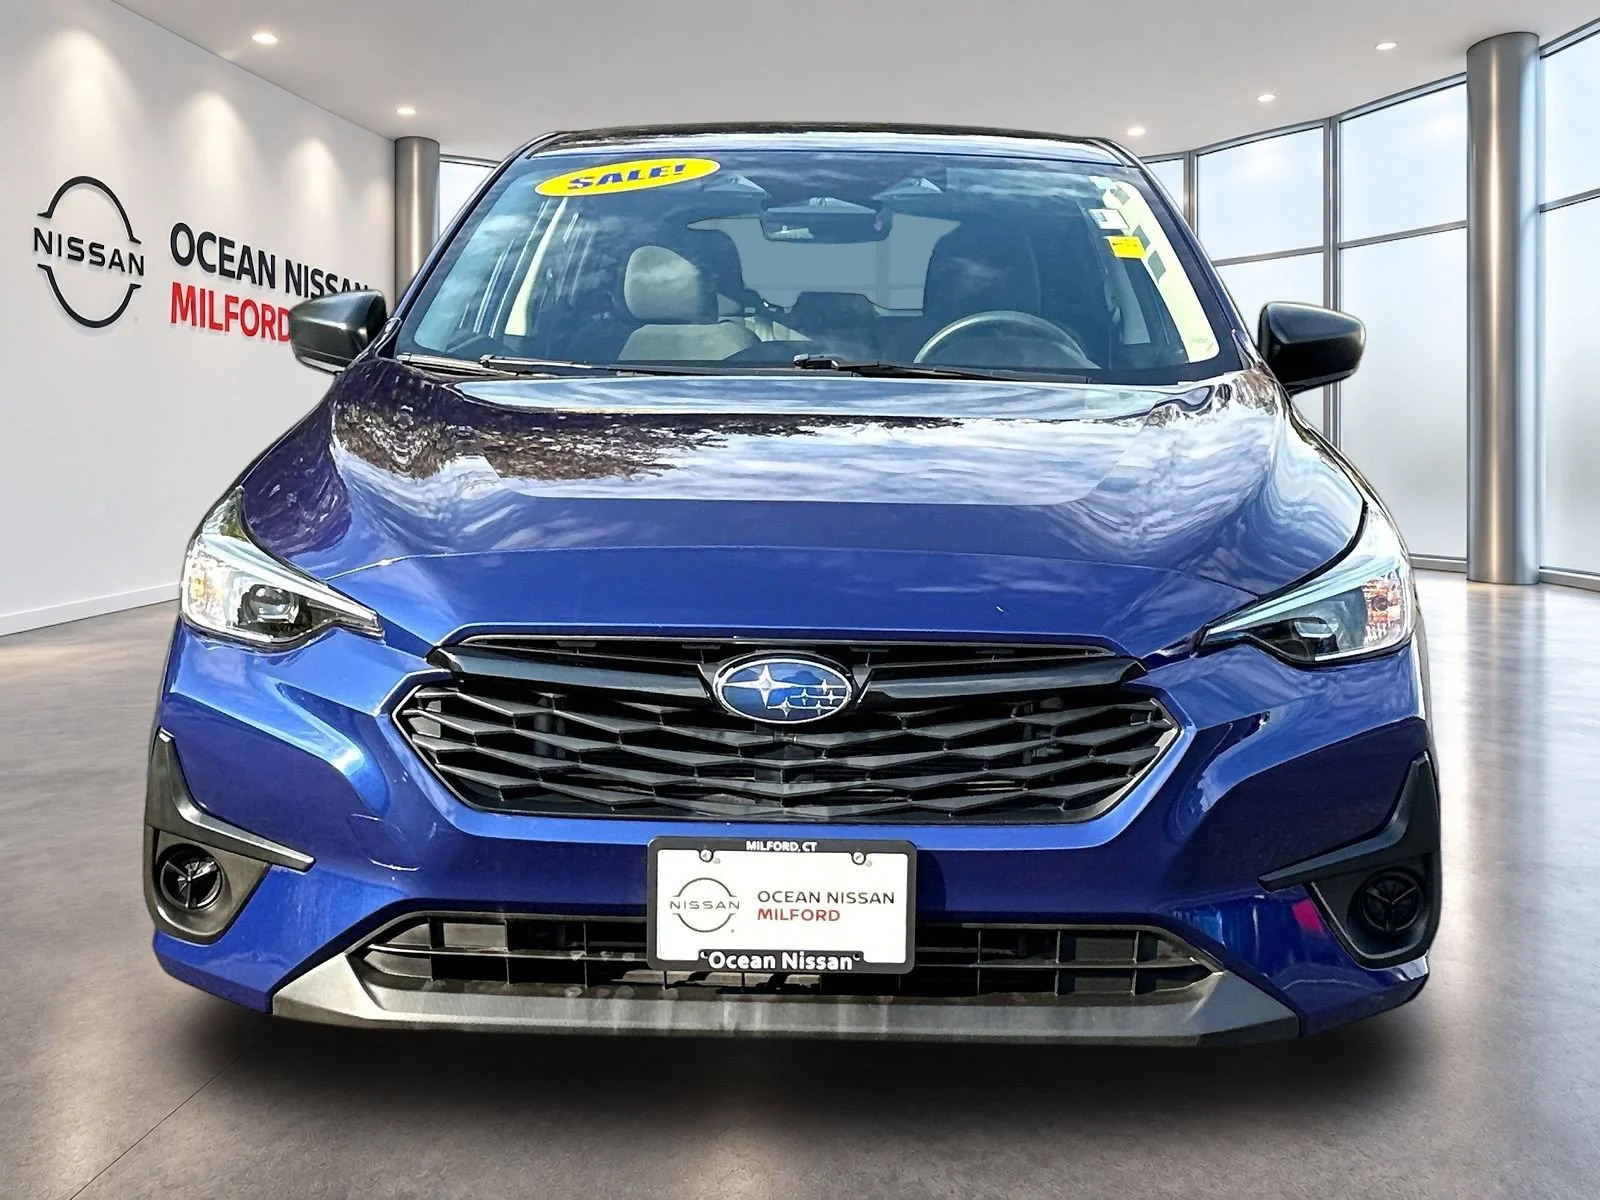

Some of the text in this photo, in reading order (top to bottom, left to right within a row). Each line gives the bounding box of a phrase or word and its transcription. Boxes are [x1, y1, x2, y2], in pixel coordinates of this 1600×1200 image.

[567, 163, 687, 190] SALE!
[33, 227, 145, 276] NISSAN
[170, 222, 276, 289] OCEAN
[170, 281, 292, 342] MILFORD
[669, 900, 740, 910] NISSAN
[757, 890, 895, 905] OCEAN NISSAN
[757, 908, 841, 922] MILFORD
[708, 950, 853, 970] Ocean Nissan
